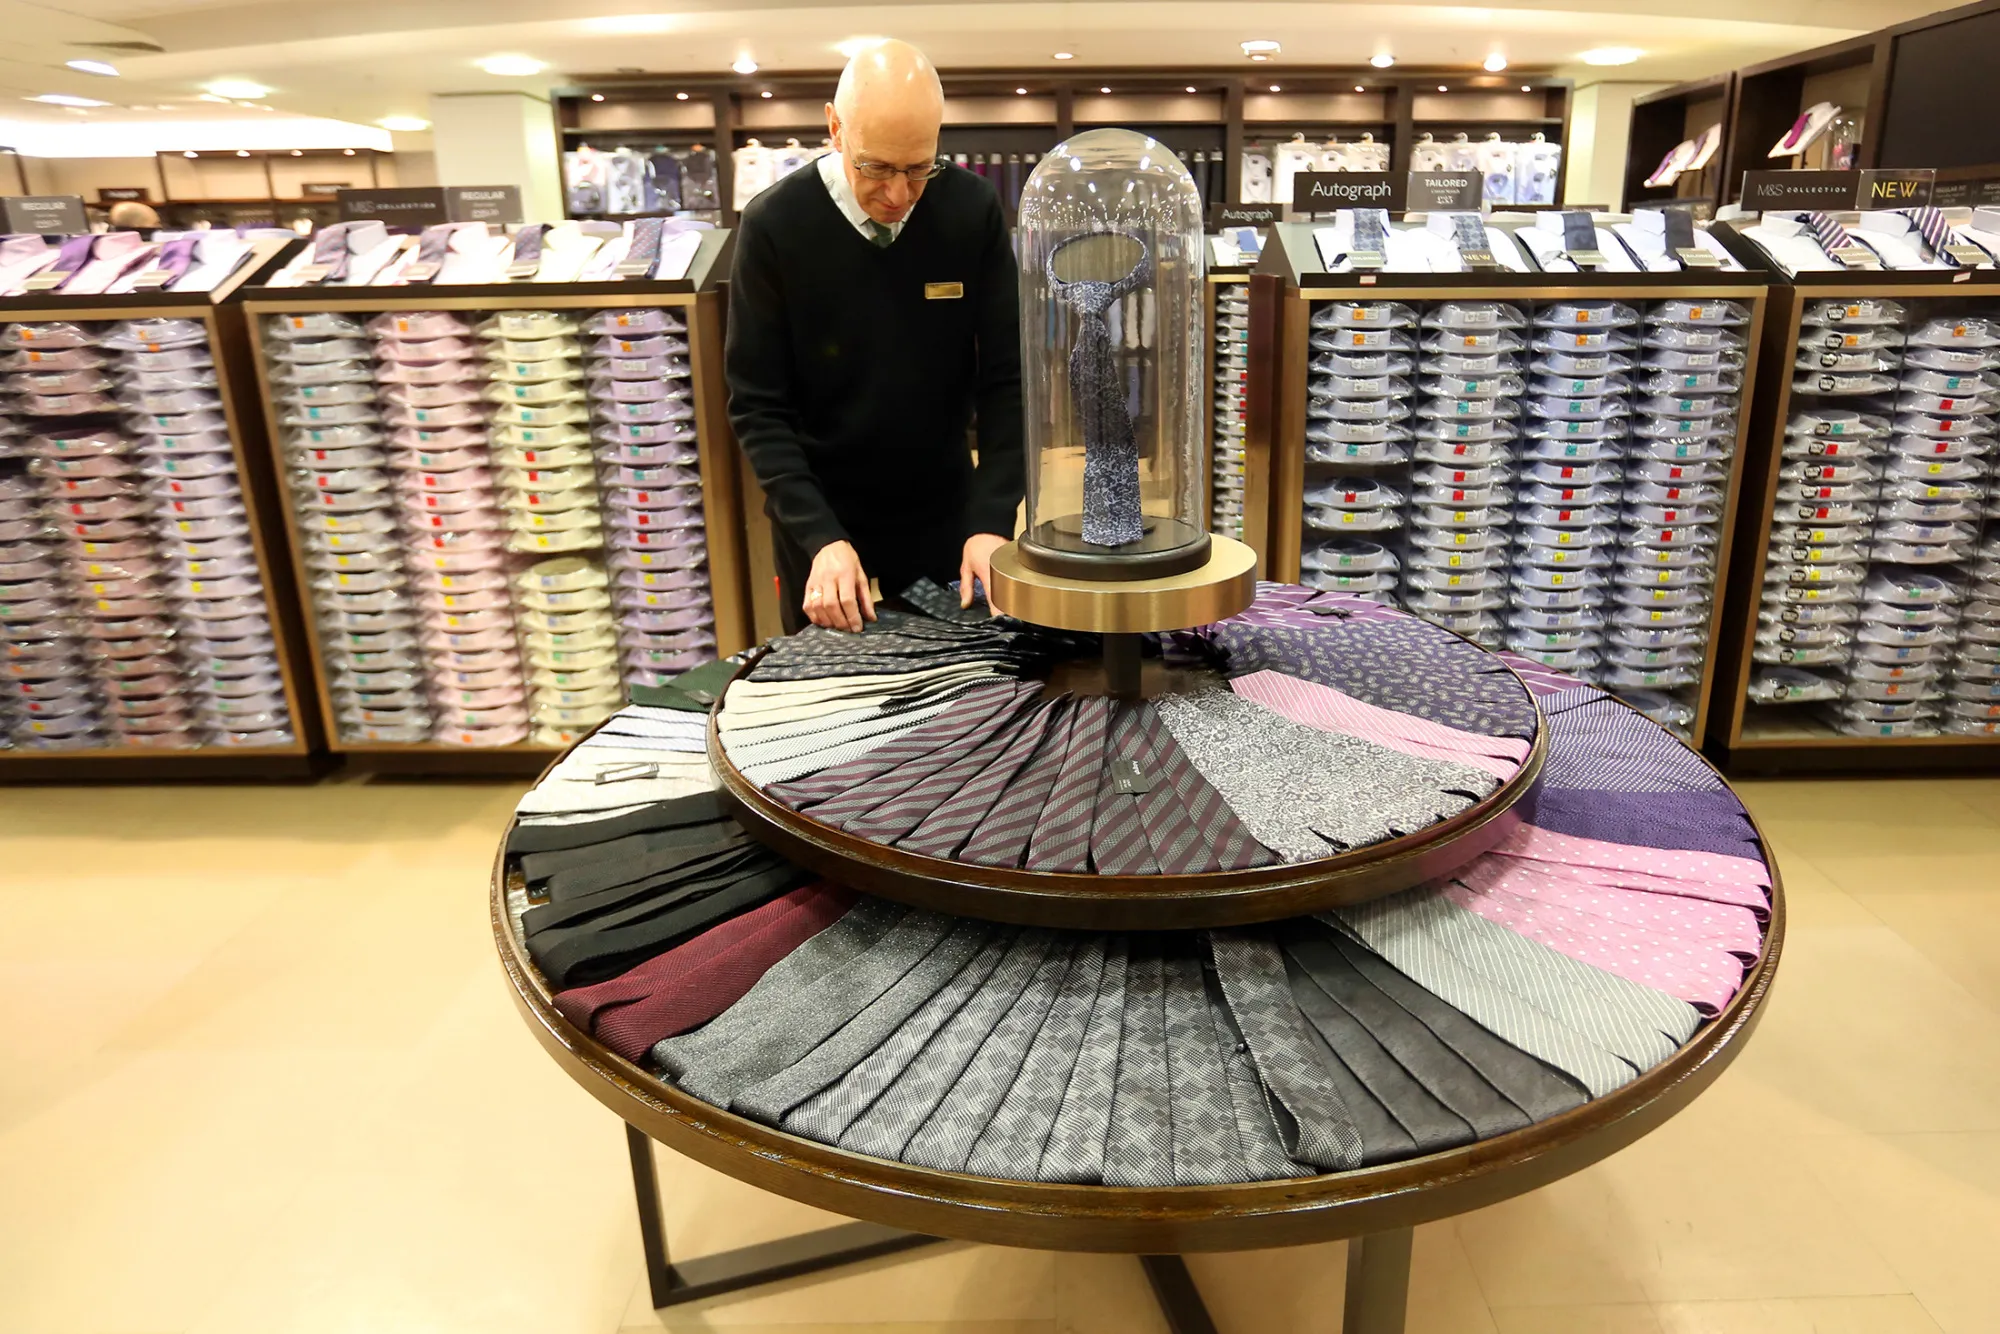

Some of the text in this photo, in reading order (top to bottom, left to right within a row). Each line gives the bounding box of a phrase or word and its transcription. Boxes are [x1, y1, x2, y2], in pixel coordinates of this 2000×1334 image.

[1424, 178, 1468, 188] TAILORED
[460, 191, 506, 200] REGULAR
[1311, 180, 1392, 201] Autograph
[1756, 183, 1848, 197] M&S COLLECTION
[1871, 181, 1918, 198] NEW
[20, 202, 67, 211] REGULAR
[348, 201, 375, 213] M&S
[1221, 208, 1274, 222] Autograph
[1462, 253, 1491, 262] NEW
